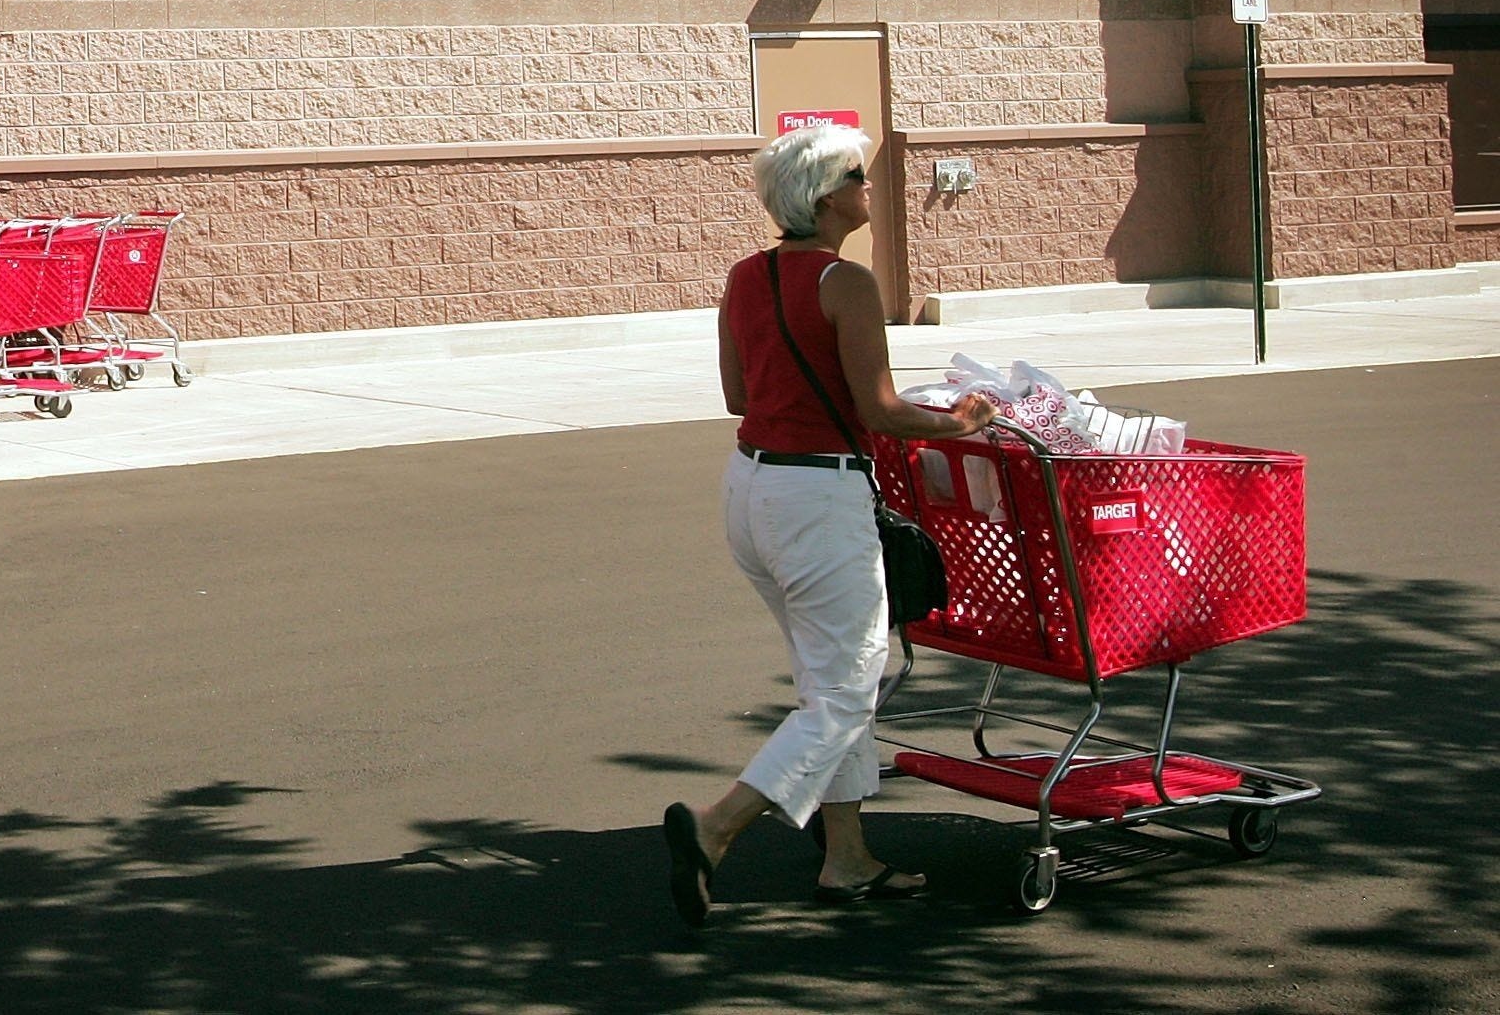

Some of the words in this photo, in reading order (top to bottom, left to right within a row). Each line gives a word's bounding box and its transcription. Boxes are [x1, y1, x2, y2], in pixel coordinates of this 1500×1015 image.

[783, 115, 805, 128] Fire
[807, 115, 834, 127] Door
[1092, 502, 1137, 520] TARGET
